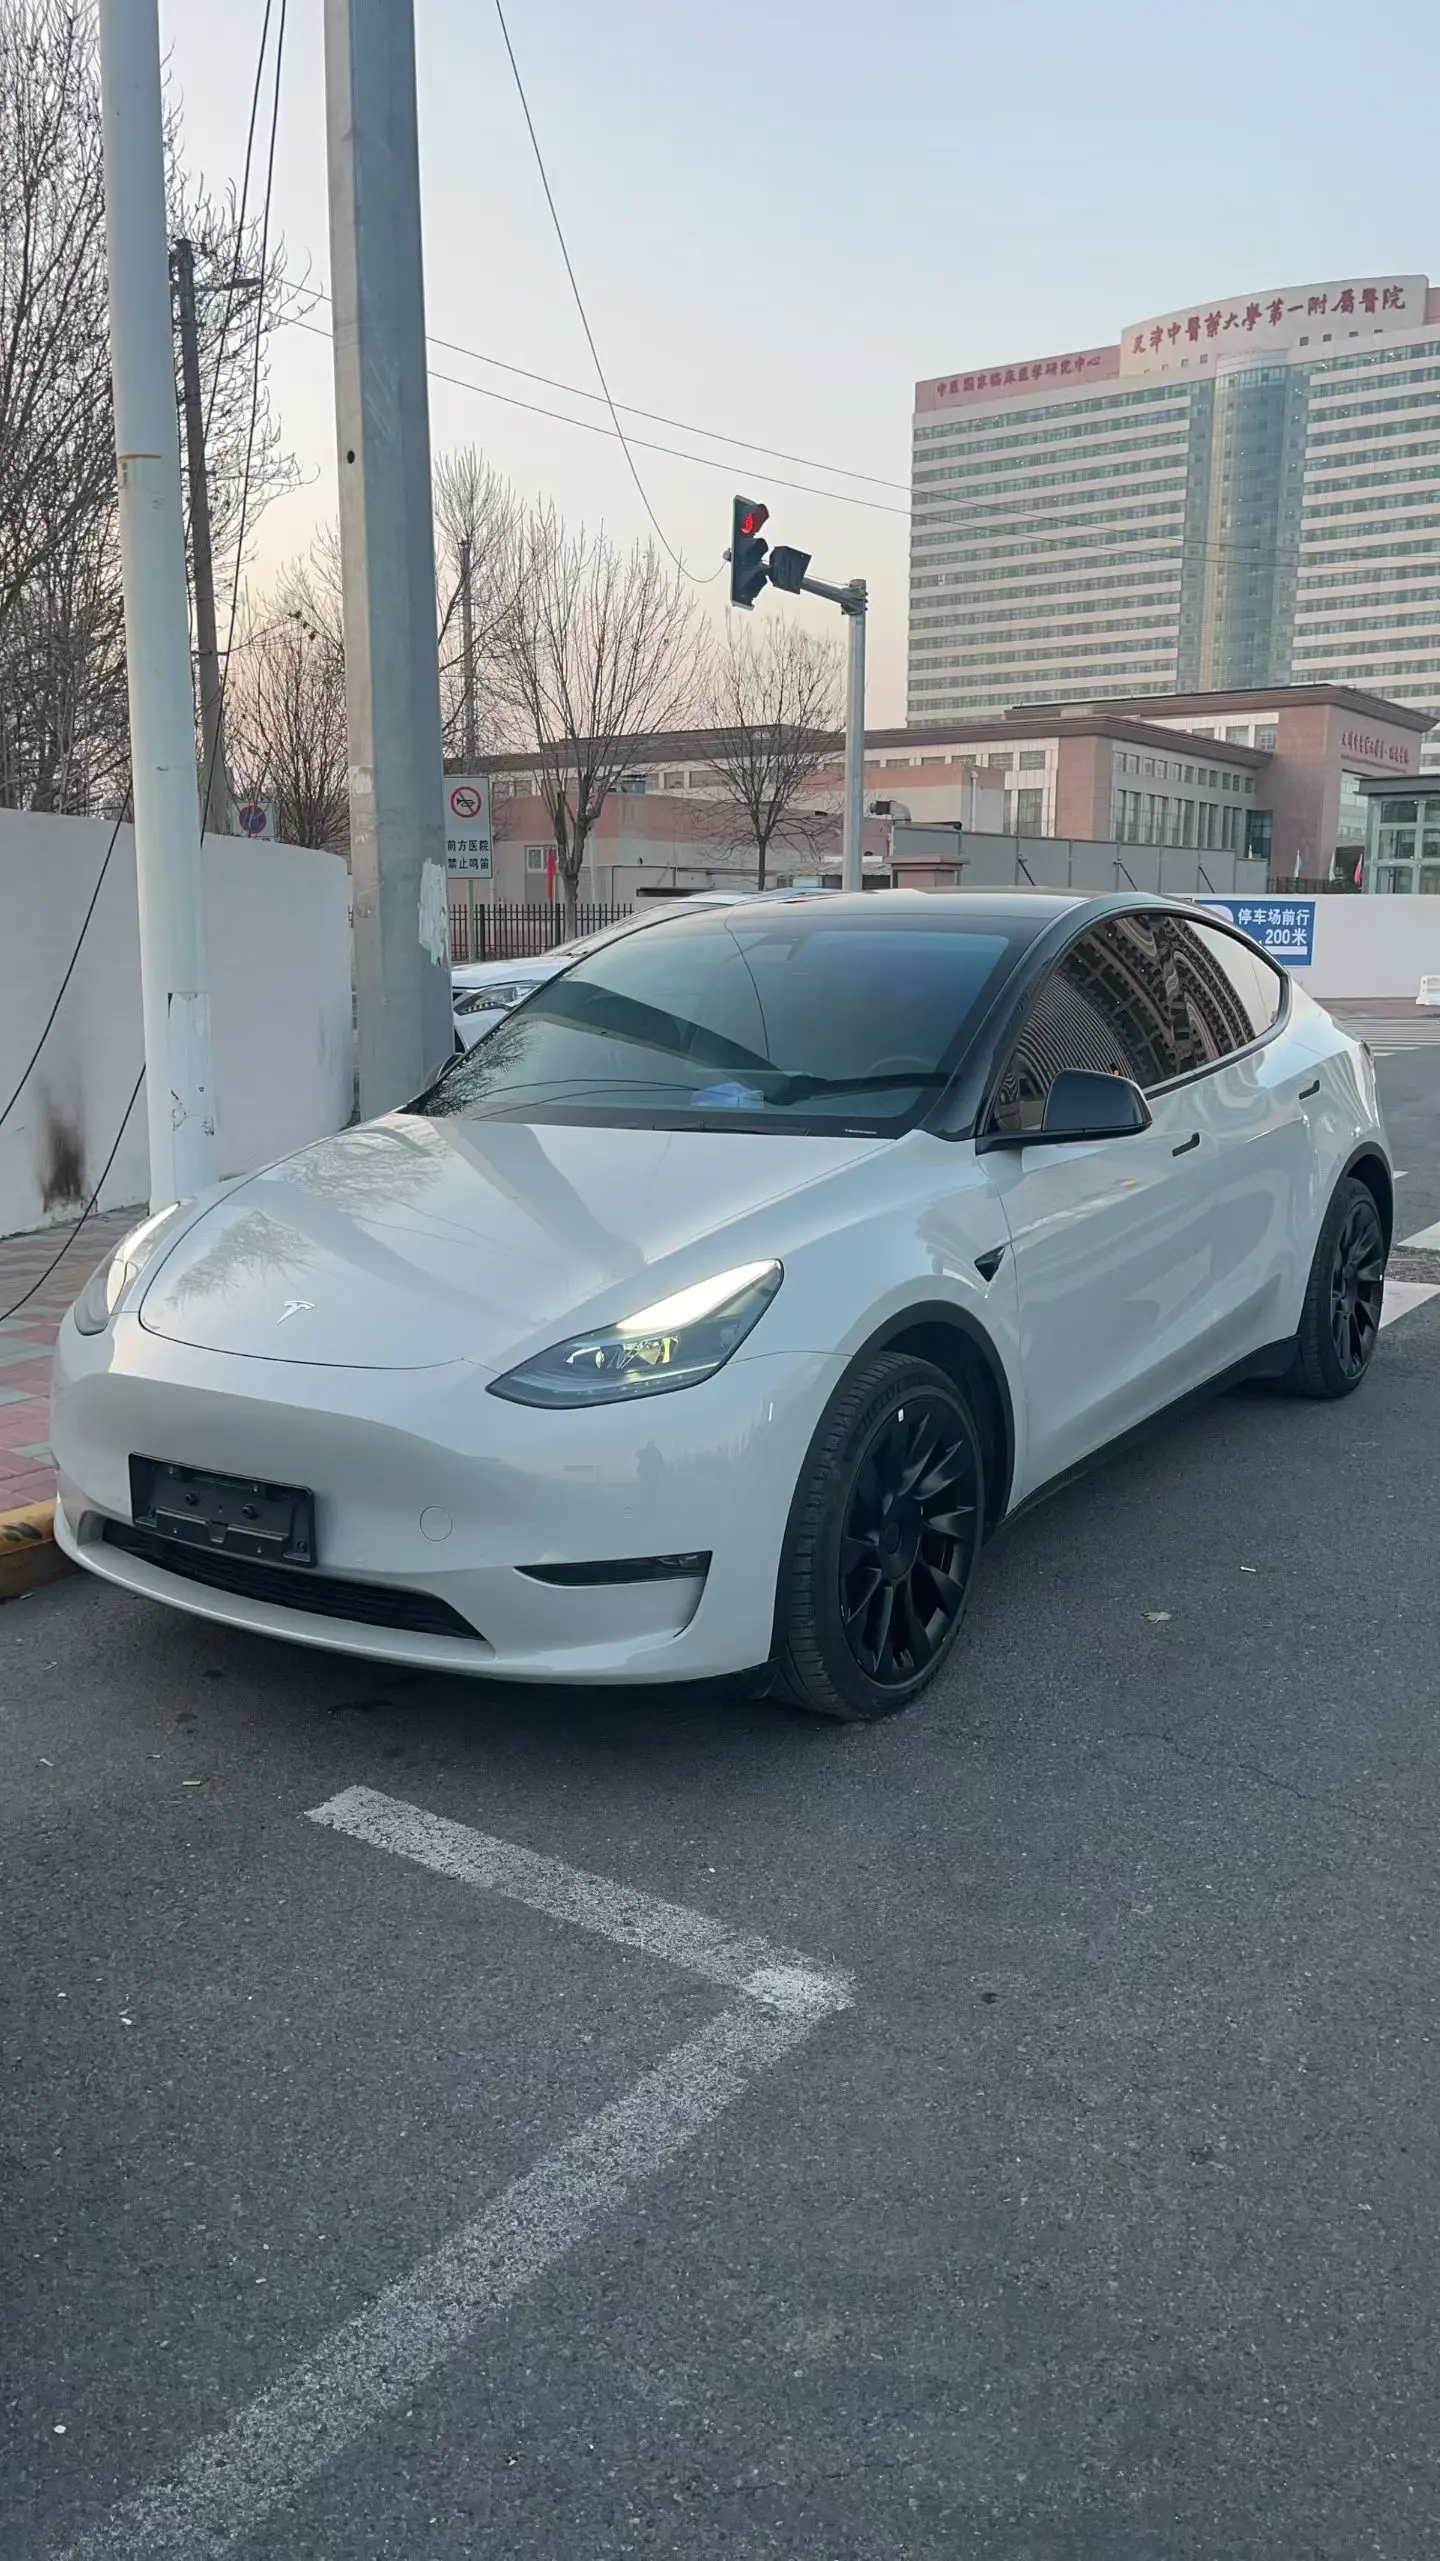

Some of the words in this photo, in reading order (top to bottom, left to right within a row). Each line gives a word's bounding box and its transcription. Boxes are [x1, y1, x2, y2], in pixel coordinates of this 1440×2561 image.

[447, 840, 489, 852] 前方医院
[447, 858, 489, 870] 禁止鸣笛
[1238, 907, 1310, 926] 停车场前行
[1265, 928, 1307, 946] 200米
